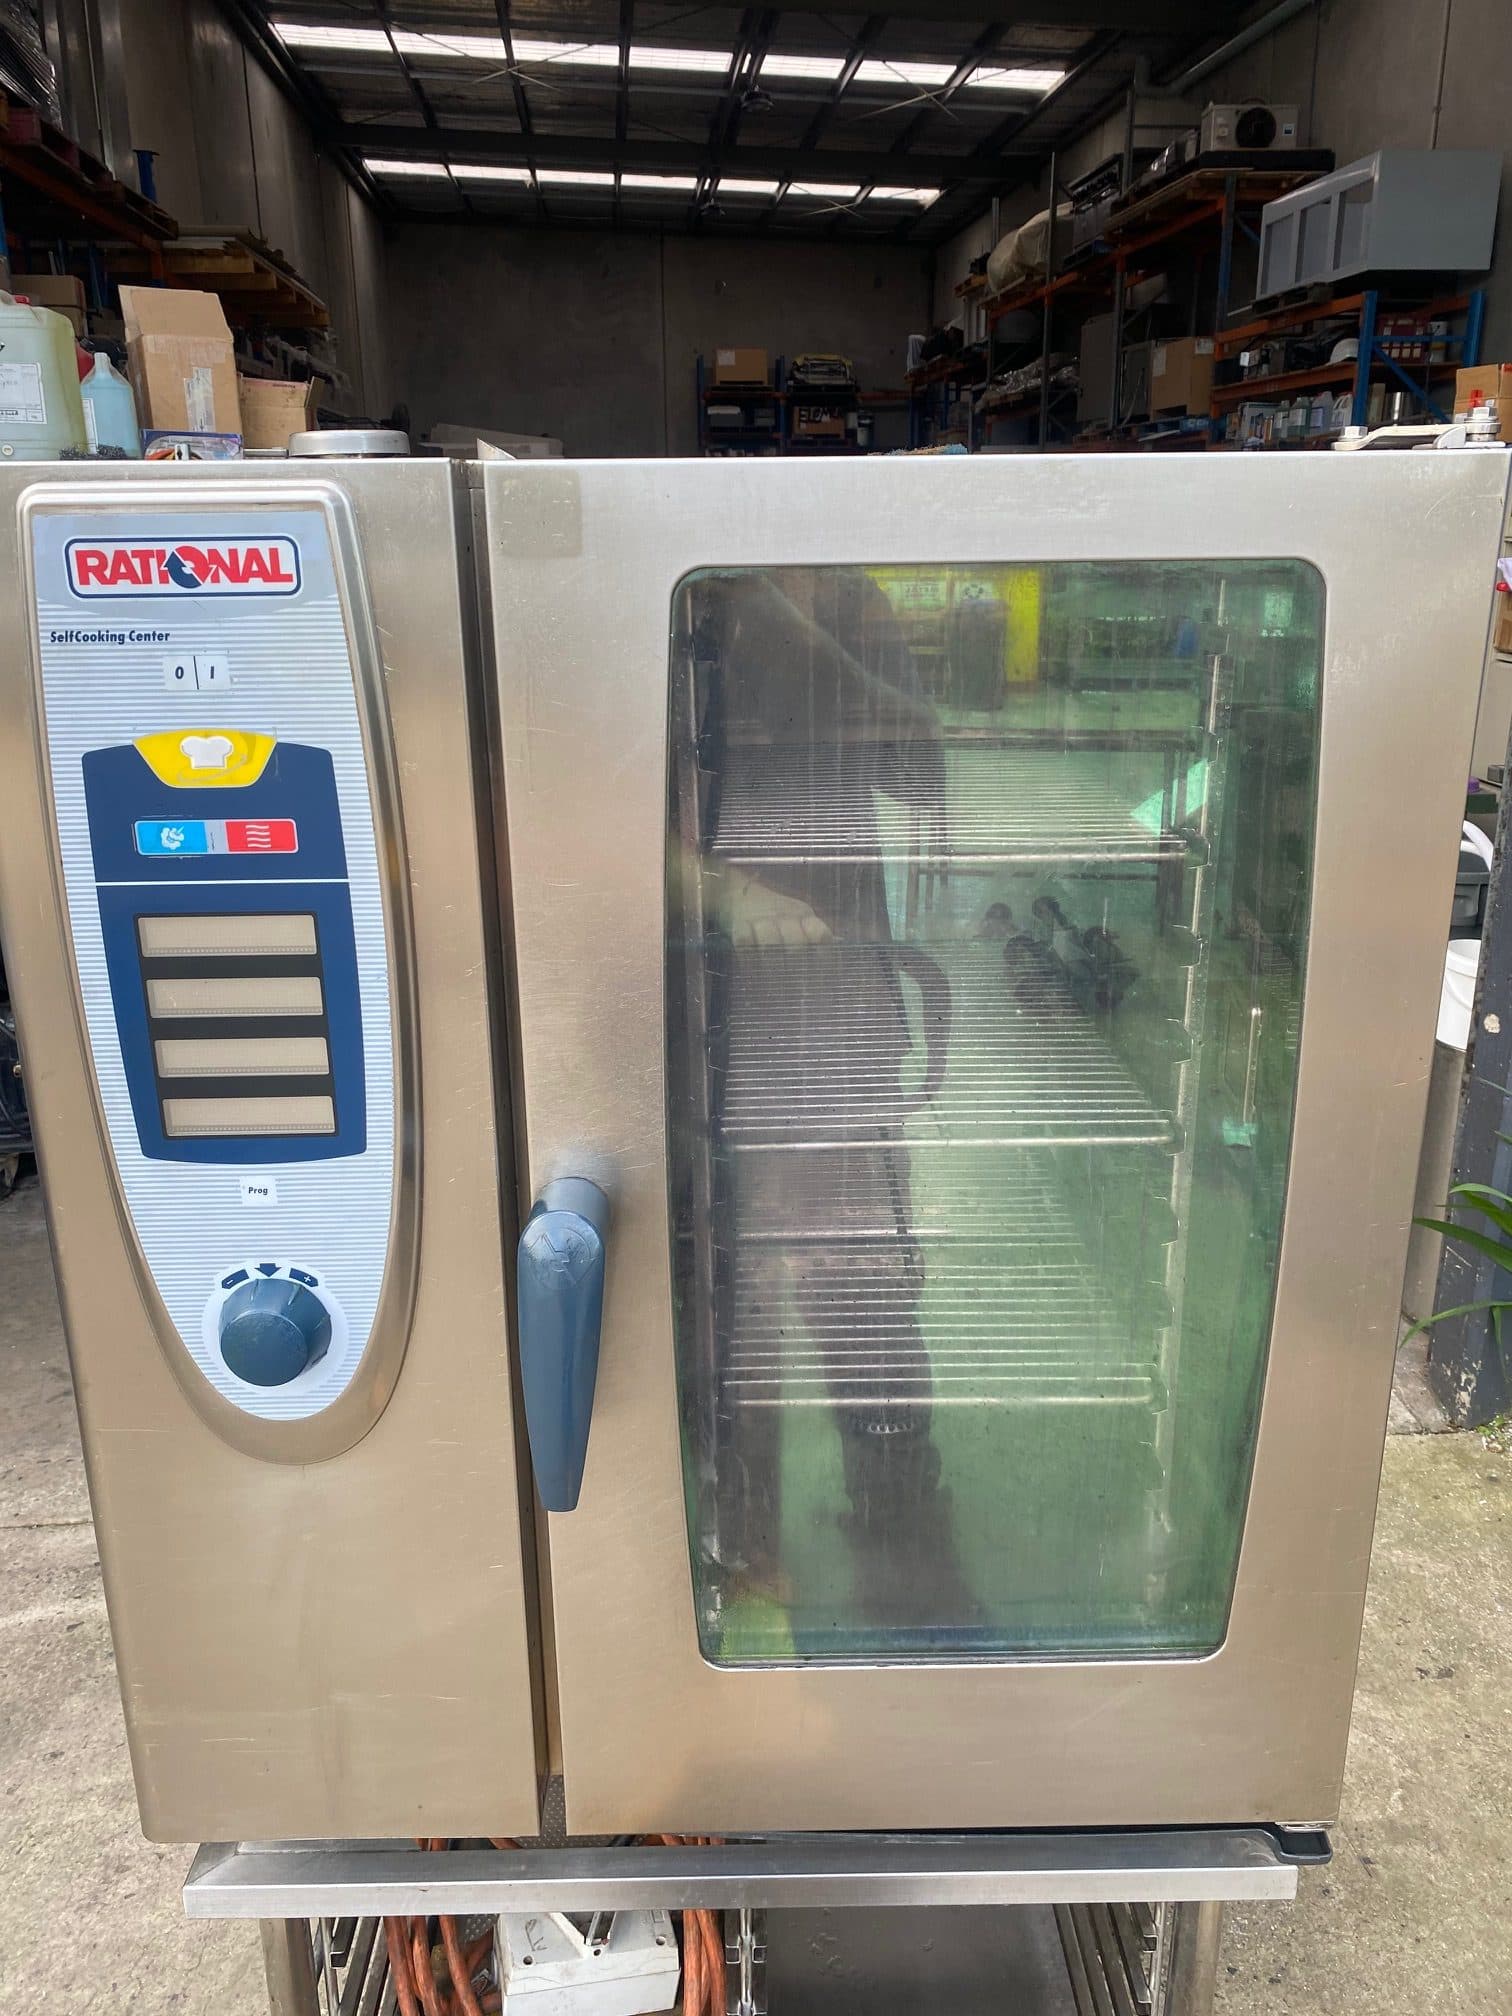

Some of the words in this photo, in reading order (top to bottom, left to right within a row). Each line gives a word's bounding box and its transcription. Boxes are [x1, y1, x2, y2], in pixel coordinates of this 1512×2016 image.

[74, 545, 294, 589] RATIONAL
[50, 629, 126, 645] SelfCooking
[128, 630, 171, 644] Center
[248, 1186, 269, 1196] Prog
